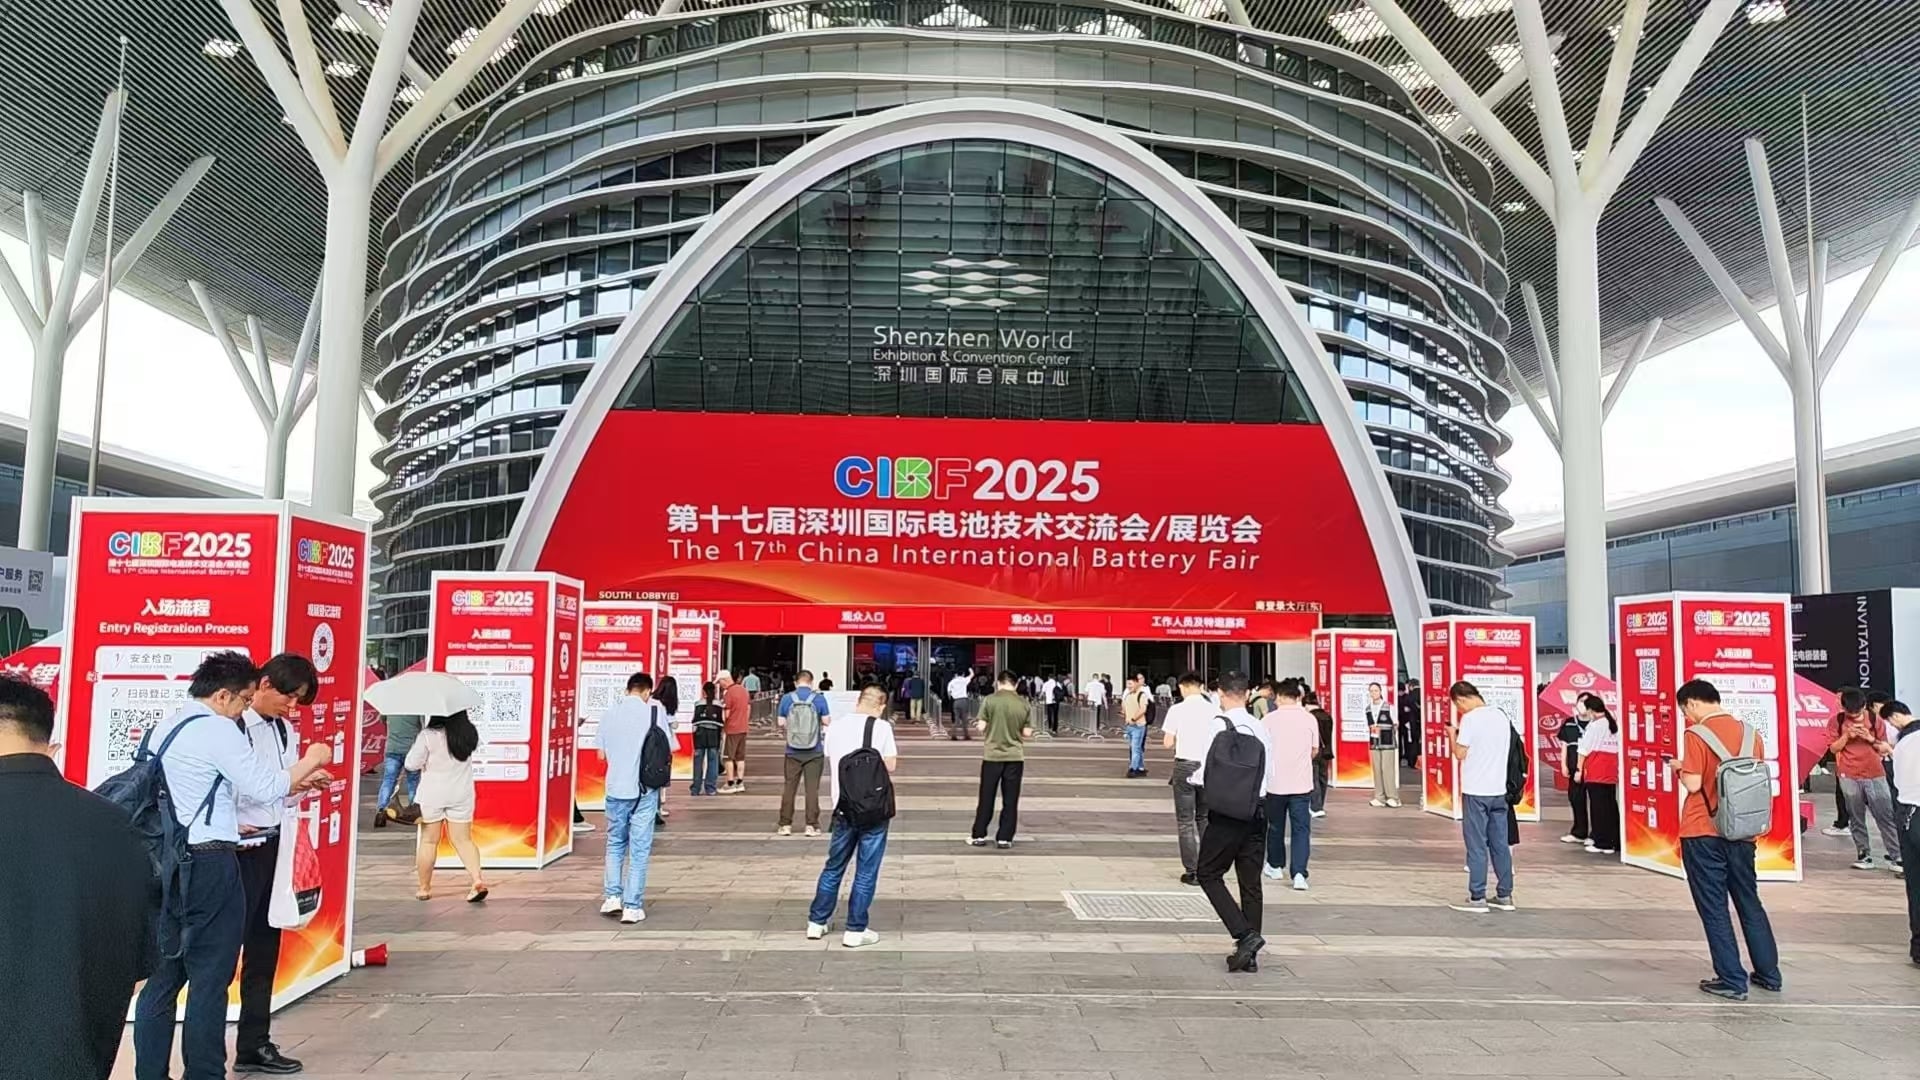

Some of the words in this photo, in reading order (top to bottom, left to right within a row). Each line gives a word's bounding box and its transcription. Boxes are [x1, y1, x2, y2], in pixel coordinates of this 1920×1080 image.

[873, 326, 990, 348] Shenzhen
[1000, 329, 1073, 349] World
[873, 349, 936, 362] Exhibition
[940, 351, 950, 362] &
[953, 351, 1026, 364] Convention
[1028, 353, 1071, 365] Center
[873, 366, 1069, 386] 深圳国际会展中心
[834, 456, 1100, 502] CIBF2025
[666, 503, 1262, 544] 第十七届深圳国际电池技术交流会/展览会
[108, 531, 251, 557] CIBF2025
[297, 538, 354, 568] CIBF2025
[668, 539, 720, 560] The
[734, 540, 787, 562] 17th
[798, 542, 880, 564] China
[893, 543, 1079, 569] International
[1092, 547, 1196, 574] Battery
[1208, 549, 1260, 570] Fair
[599, 591, 632, 599] SOUTH
[636, 592, 679, 600] LOBBY(E)
[141, 599, 211, 617] 入场流程
[841, 611, 885, 622] 观众入口
[99, 622, 131, 634] Entry
[133, 622, 203, 635] Registration
[205, 623, 249, 634] Process
[1011, 614, 1053, 625] 观众入口
[1694, 610, 1771, 627] CIBF2025
[1857, 596, 1870, 688] INVITATION
